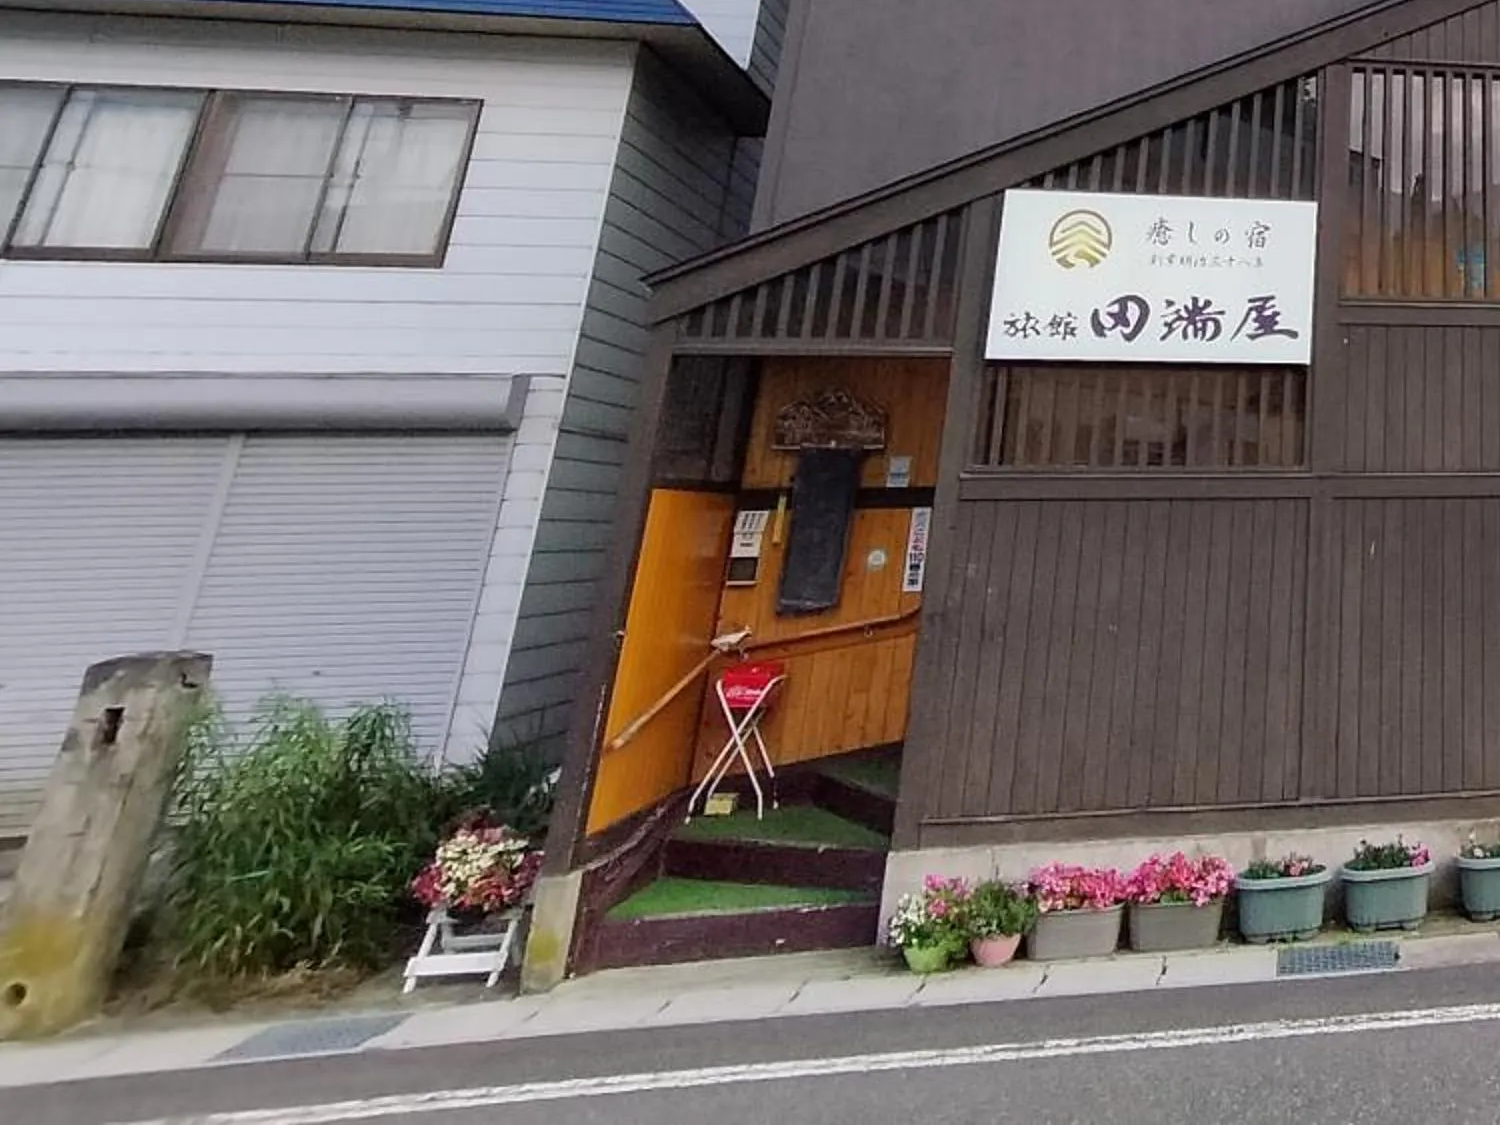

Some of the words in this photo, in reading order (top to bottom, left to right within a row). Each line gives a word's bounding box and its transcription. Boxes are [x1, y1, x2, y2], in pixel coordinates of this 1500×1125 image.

[1147, 217, 1272, 249] 癒しの宿
[1003, 311, 1079, 340] 旅館
[1090, 294, 1299, 342] 田端屋
